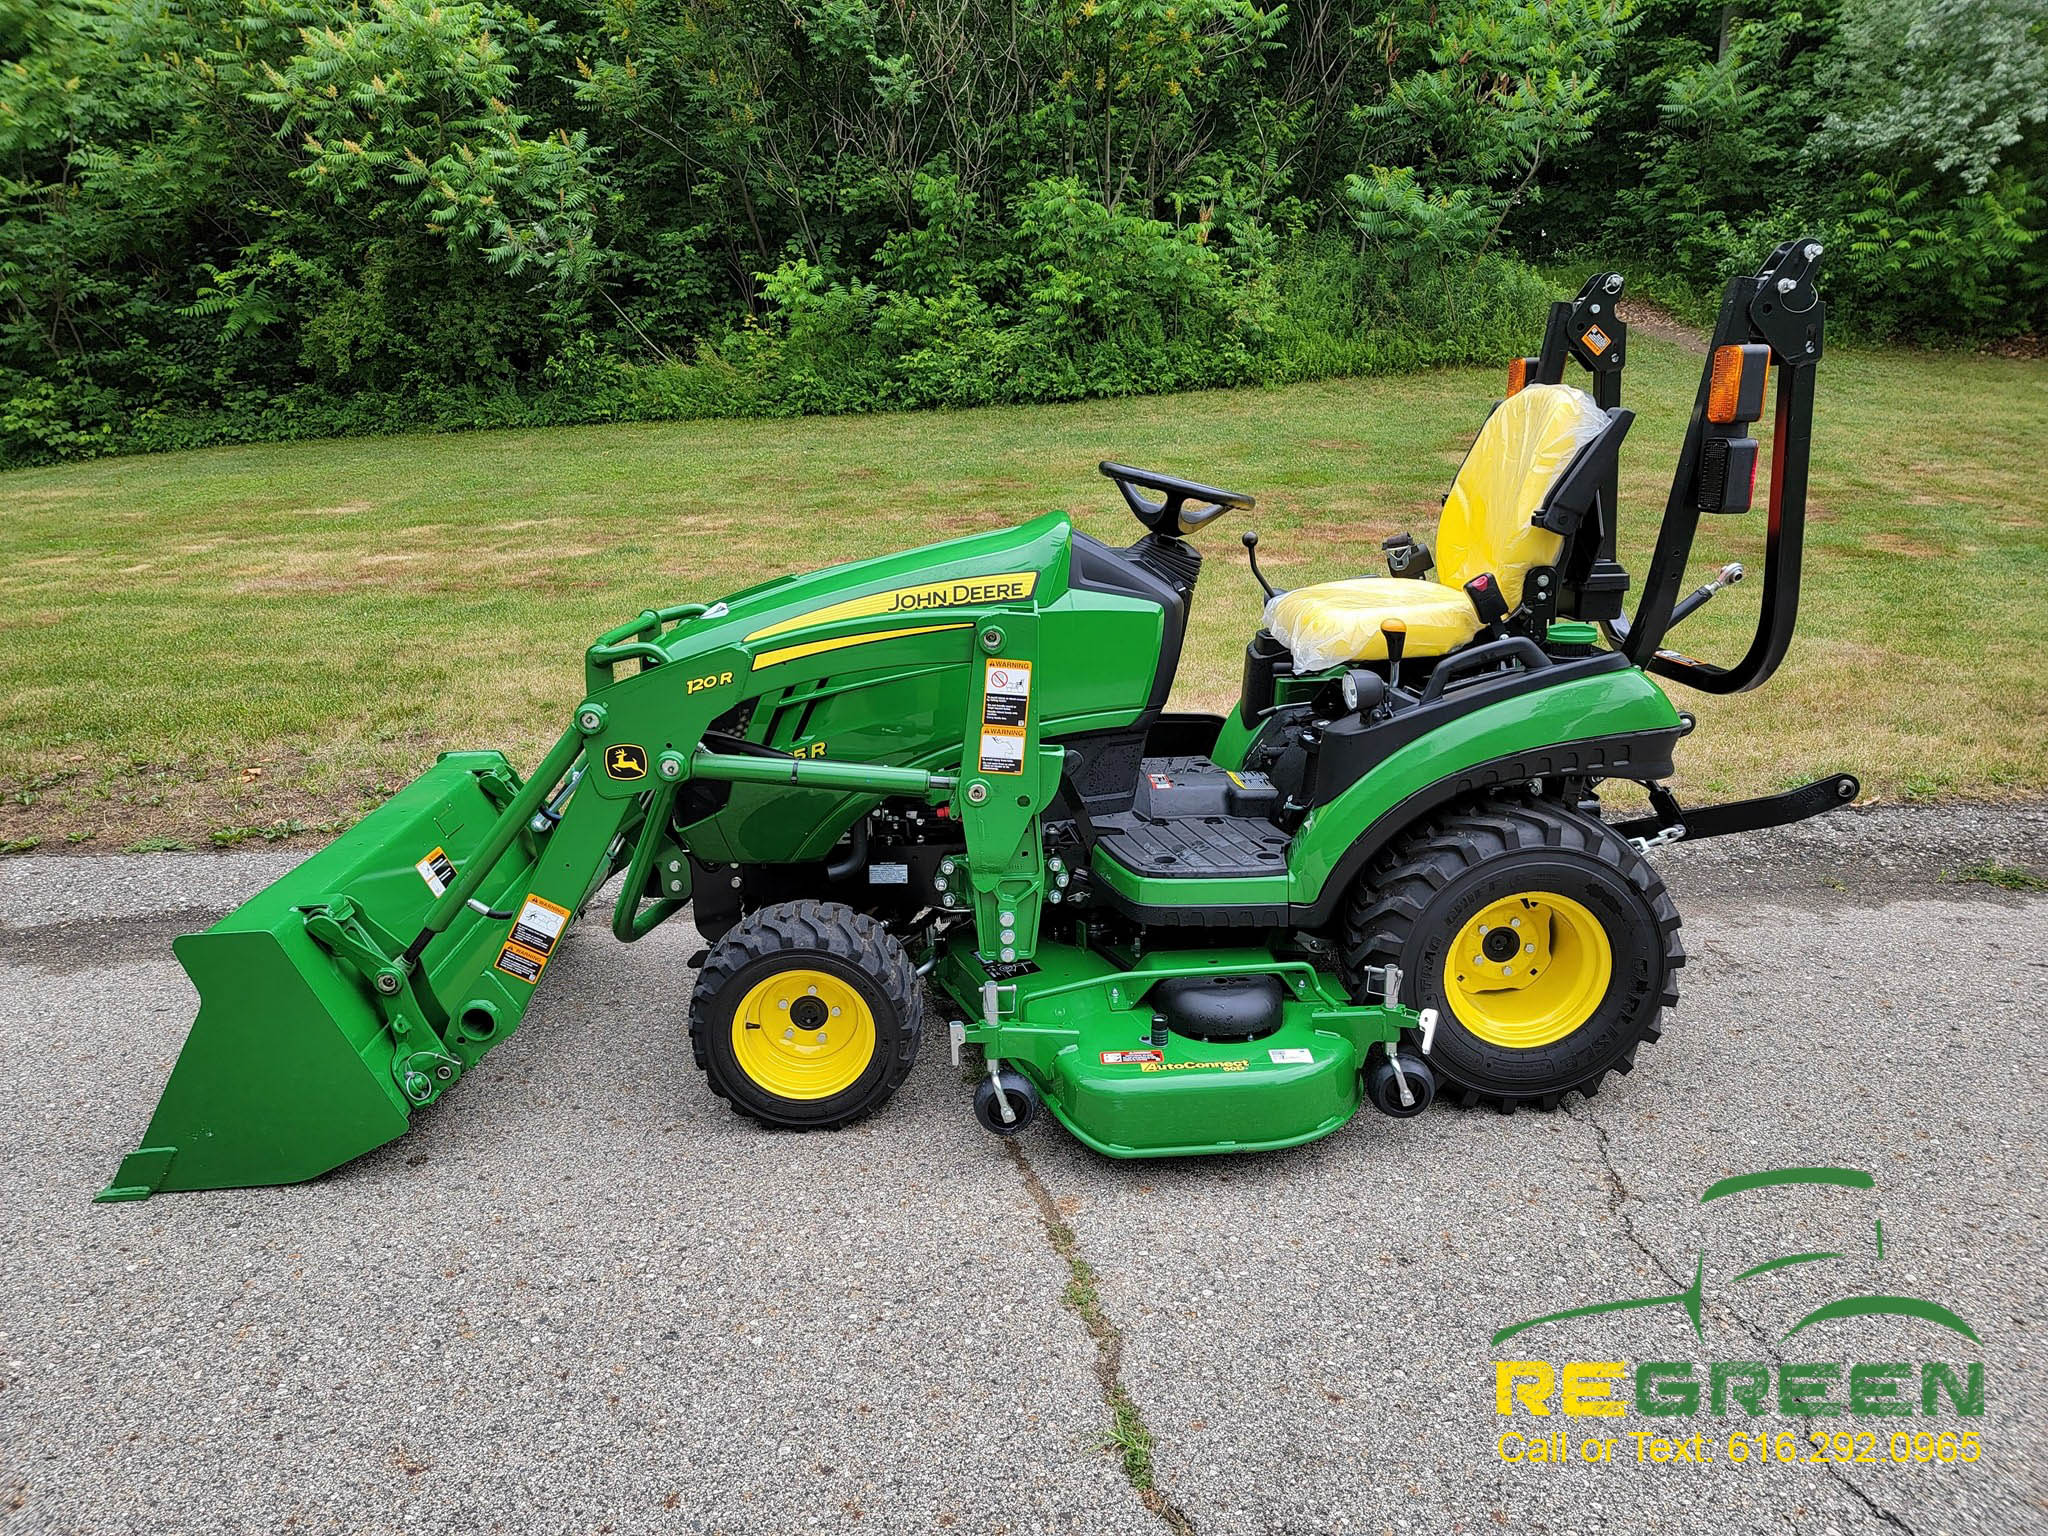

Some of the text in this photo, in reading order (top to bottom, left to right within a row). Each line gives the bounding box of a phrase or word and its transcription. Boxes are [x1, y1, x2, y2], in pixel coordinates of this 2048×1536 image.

[888, 583, 1024, 612] JOHN DEERE
[686, 671, 735, 696] 120 R
[811, 742, 827, 760] R
[1144, 1059, 1249, 1072] AutoConnect
